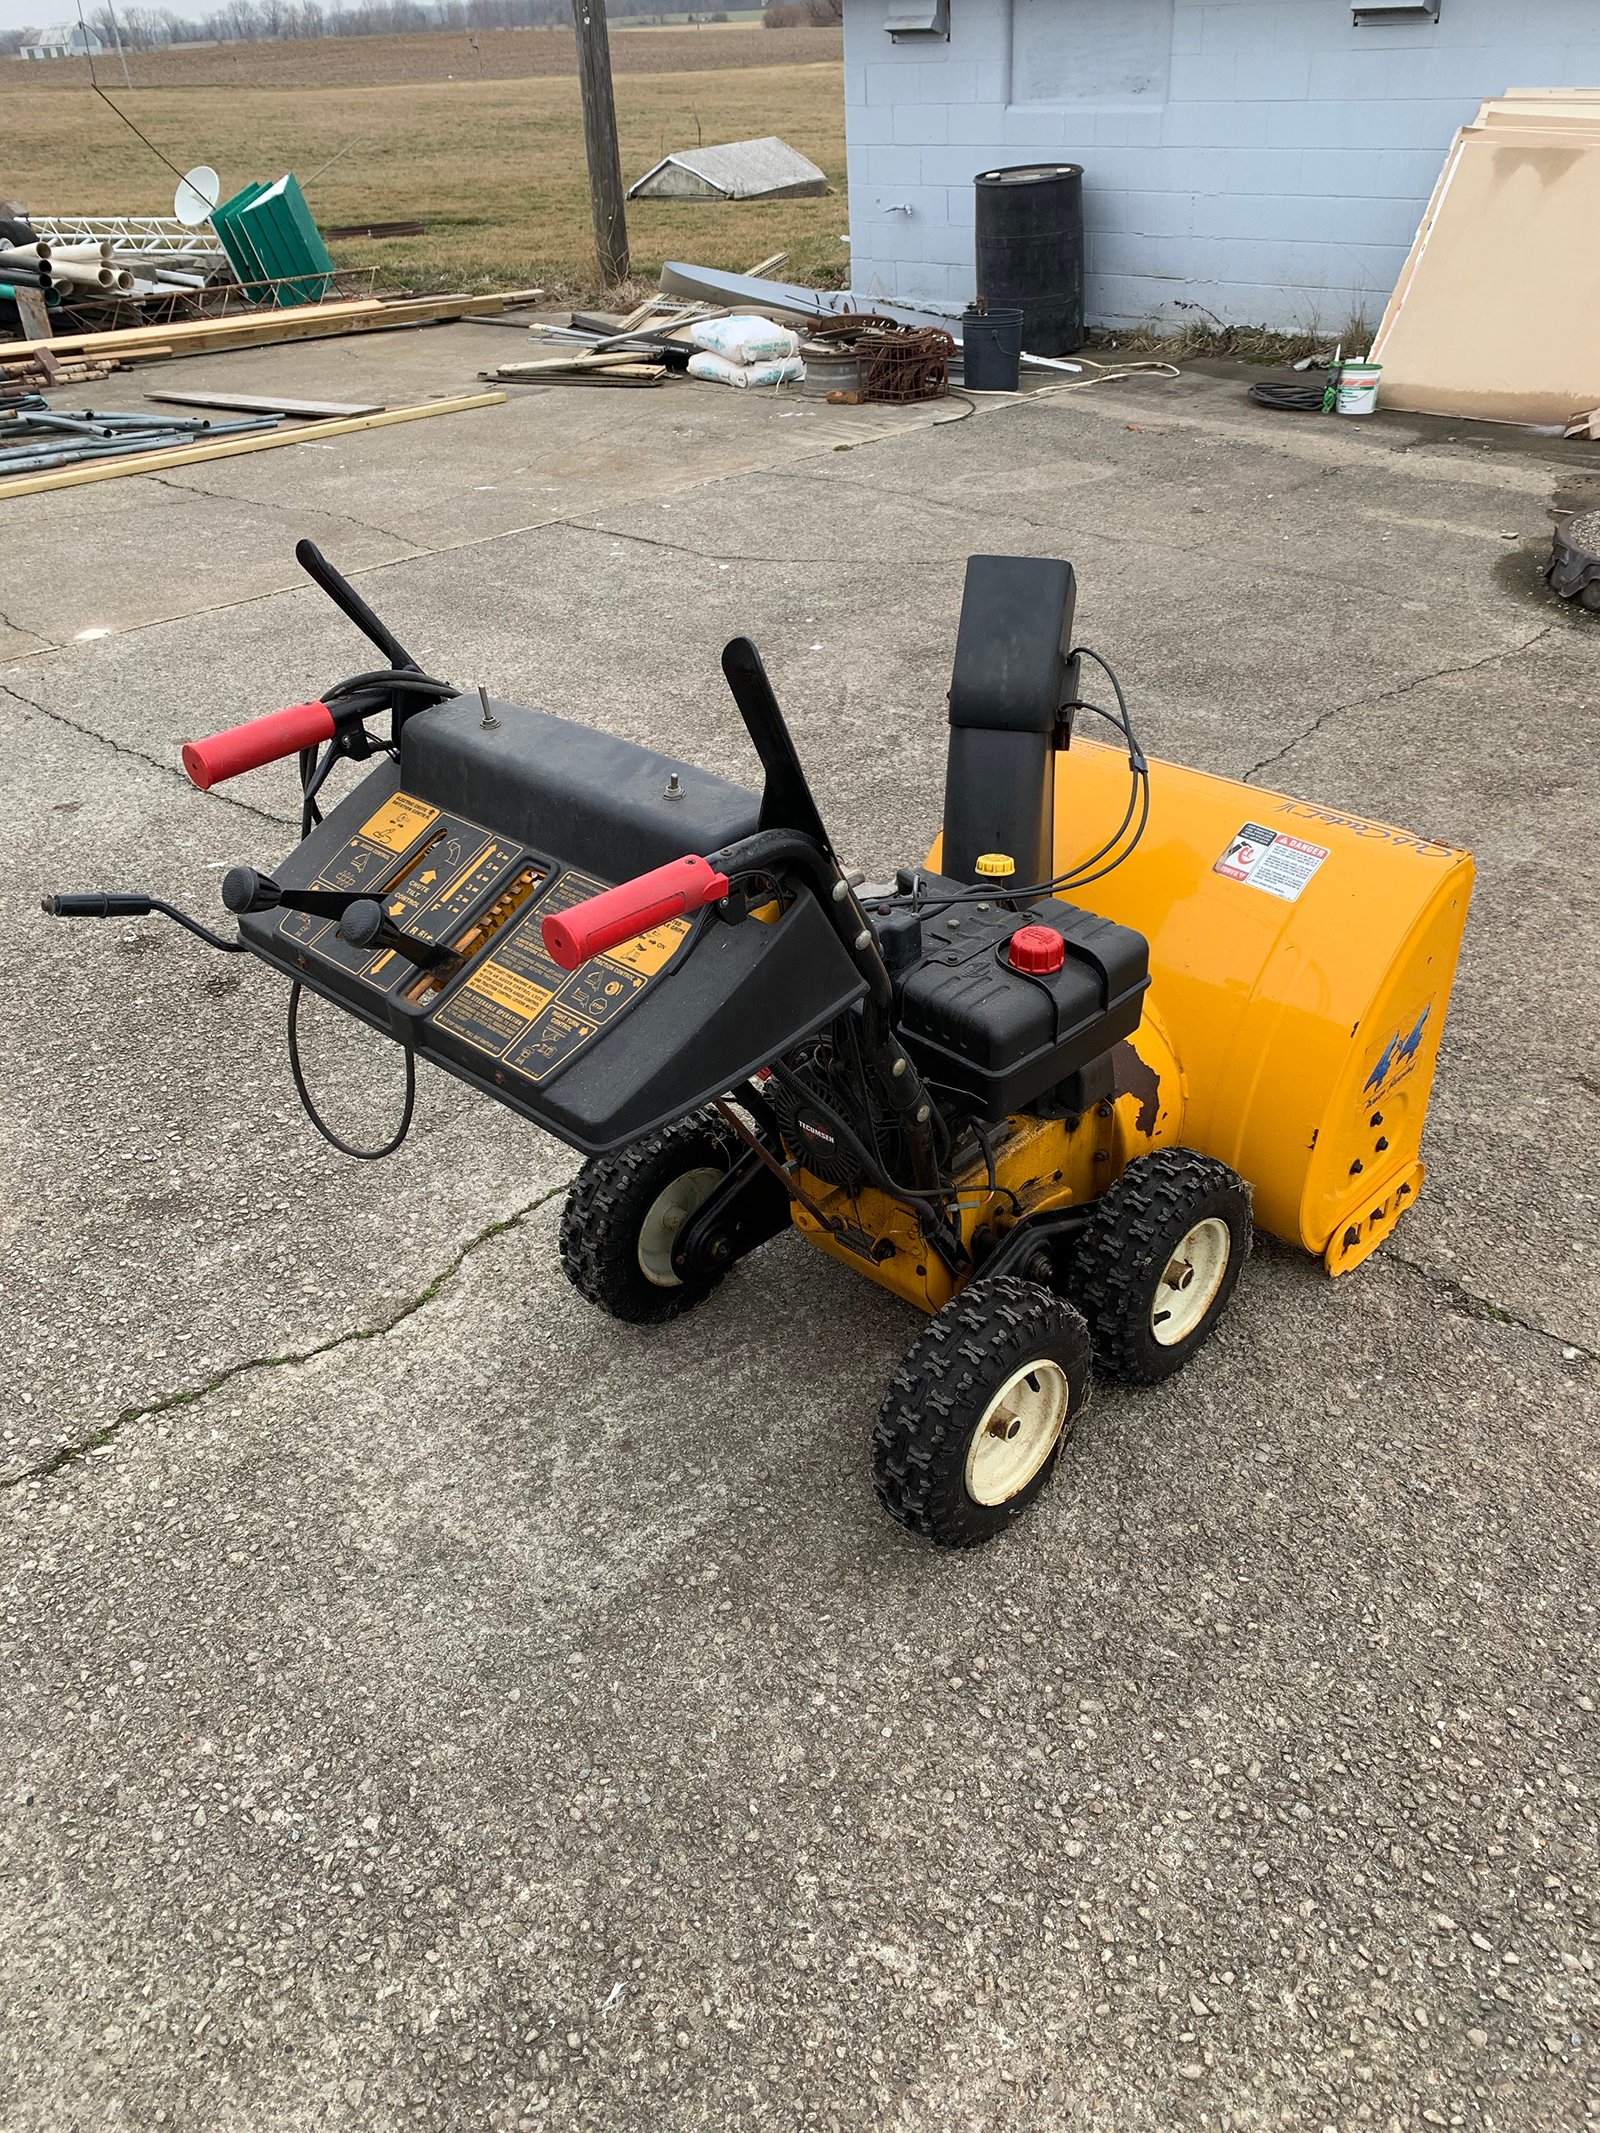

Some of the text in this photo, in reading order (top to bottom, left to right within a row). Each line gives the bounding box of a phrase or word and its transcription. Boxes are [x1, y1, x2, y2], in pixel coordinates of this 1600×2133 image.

[1289, 839, 1325, 858] DANGER
[1392, 836, 1452, 858] Cub
[496, 851, 504, 859] 6
[406, 888, 420, 898] TILT
[409, 880, 430, 893] CHUTE
[465, 883, 473, 891] 3
[394, 892, 420, 908] CONTROL
[431, 903, 441, 911] F
[409, 926, 419, 935] R
[657, 942, 666, 950] ON
[592, 956, 635, 981] TRACTION CONTROL
[460, 989, 472, 998] FOR
[470, 994, 497, 1011] STEERABLE
[592, 1002, 604, 1010] STOP
[551, 1017, 572, 1032] CONTROL
[552, 1010, 580, 1028] RIGHT TURN
[798, 1120, 835, 1144] TECUMSEH
